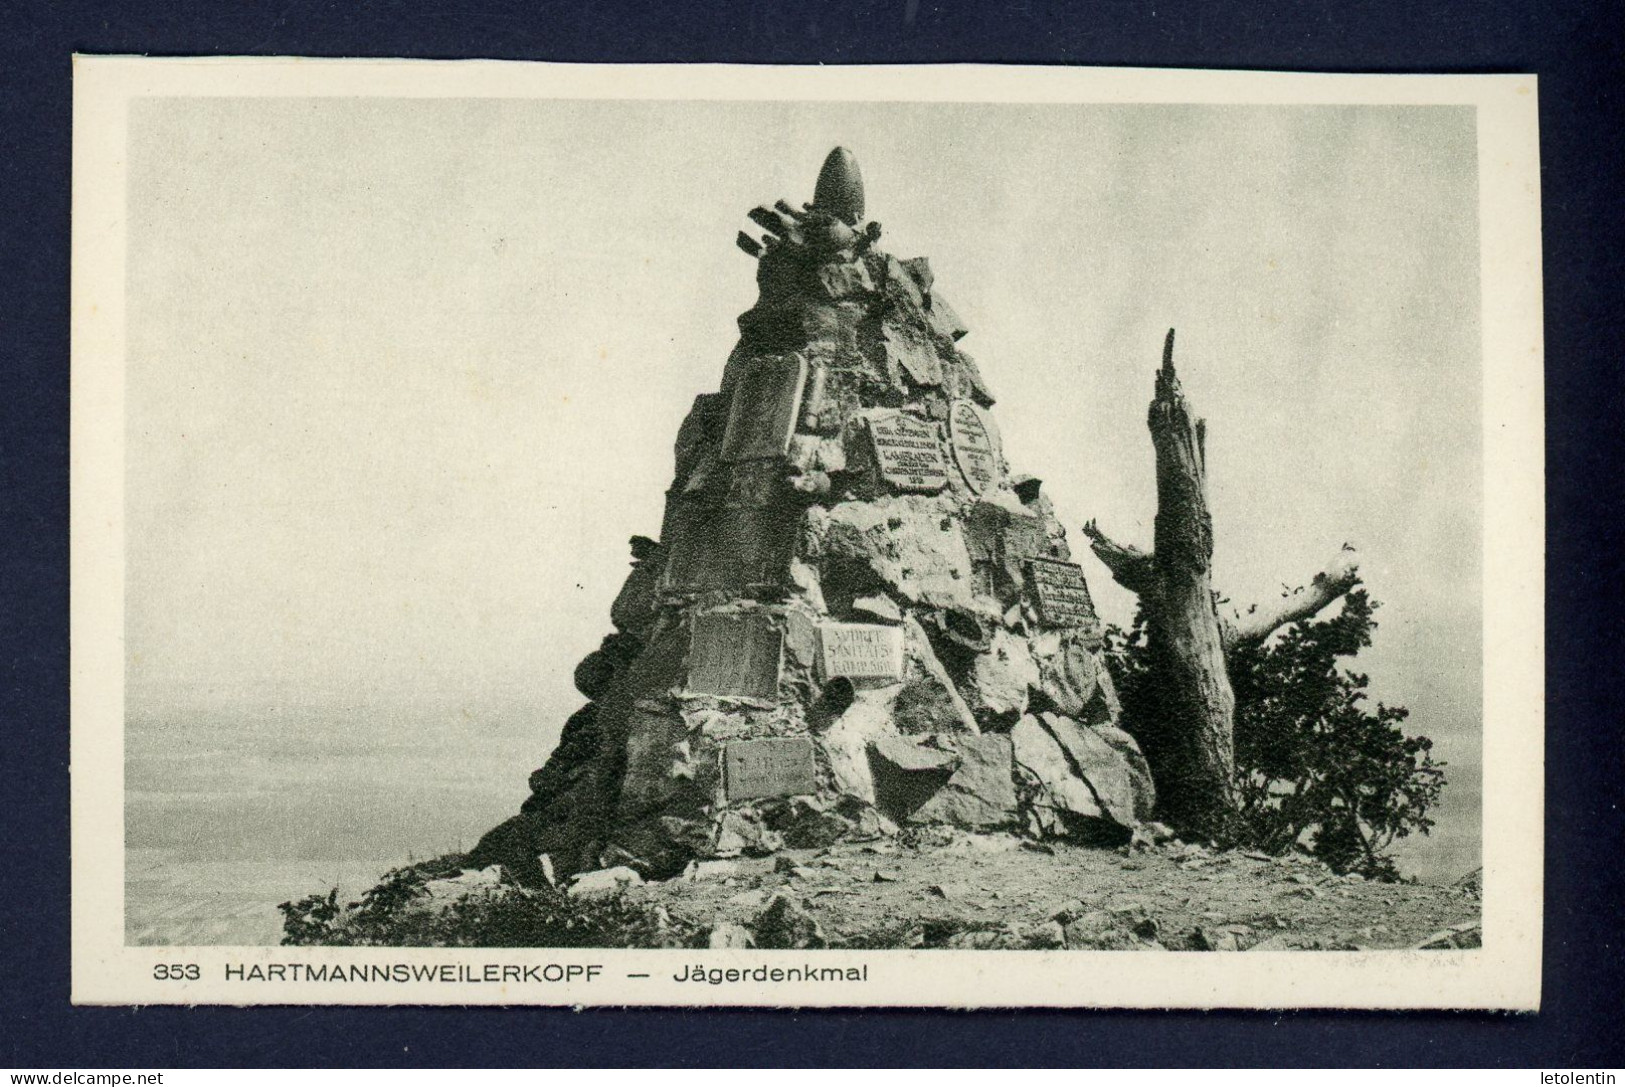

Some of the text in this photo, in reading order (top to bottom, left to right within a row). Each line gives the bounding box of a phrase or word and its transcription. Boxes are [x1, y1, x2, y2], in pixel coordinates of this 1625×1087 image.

[153, 963, 201, 981] 353
[225, 963, 603, 983] HARTMANNSWEILERKOPF
[672, 964, 868, 985] Jägerdenkmal
